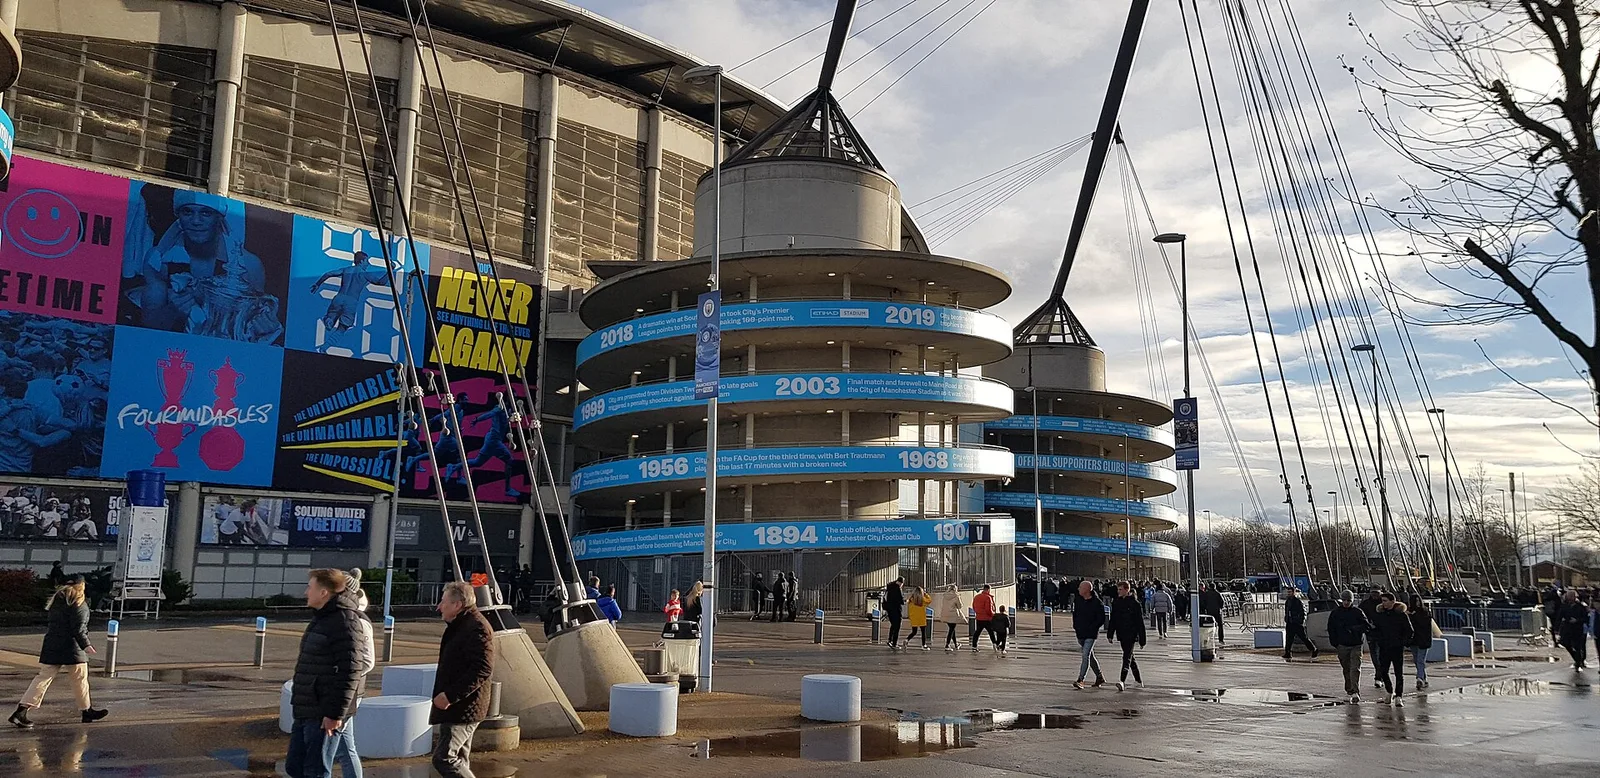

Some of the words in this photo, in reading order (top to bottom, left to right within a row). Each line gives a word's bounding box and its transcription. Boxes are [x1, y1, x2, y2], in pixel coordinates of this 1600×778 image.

[78, 211, 112, 246] IN
[435, 266, 534, 325] NEVER
[436, 310, 449, 323] SEE
[449, 312, 483, 329] ANYTHING
[483, 318, 499, 332] LIE
[514, 325, 531, 339] EVER
[643, 319, 666, 329] dramatic
[742, 308, 762, 316] City's
[885, 305, 936, 326] 2019
[600, 324, 634, 349] 2018
[638, 329, 656, 338] League
[656, 325, 674, 334] points
[681, 322, 691, 330] the
[429, 324, 533, 379] AGAIN!
[293, 413, 307, 423] THE
[306, 368, 401, 418] UNTHINKABLE
[623, 392, 647, 402] promoted
[647, 389, 660, 397] from
[660, 387, 683, 396] Division
[740, 381, 758, 389] goals
[775, 376, 841, 396] 2003
[859, 386, 873, 394] City
[917, 388, 940, 396] Stadium
[580, 397, 606, 421] 1999
[631, 399, 648, 408] penalty
[649, 396, 673, 404] shootout
[282, 432, 296, 442] THE
[297, 413, 404, 442] UNIMAGINABL
[305, 453, 318, 463] THE
[743, 455, 757, 463] Cup
[758, 453, 768, 461] for
[898, 450, 949, 469] 1968
[1052, 456, 1102, 471] SUPPORTERS
[1102, 459, 1125, 473] CLUBS
[639, 457, 689, 479] 1956
[294, 505, 334, 518] SOLVING
[334, 507, 366, 520] WATER
[296, 516, 363, 533] TOGETHER
[855, 526, 883, 534] officially
[933, 523, 969, 542] 190
[976, 526, 983, 540] V
[753, 525, 819, 545] 1894
[825, 534, 866, 542] Manchester
[867, 534, 881, 542] City
[881, 533, 906, 541] Football
[616, 544, 636, 552] changes
[637, 542, 654, 550] before
[654, 541, 682, 549] becoming
[682, 538, 722, 548] Mancher
[722, 538, 737, 546] City
